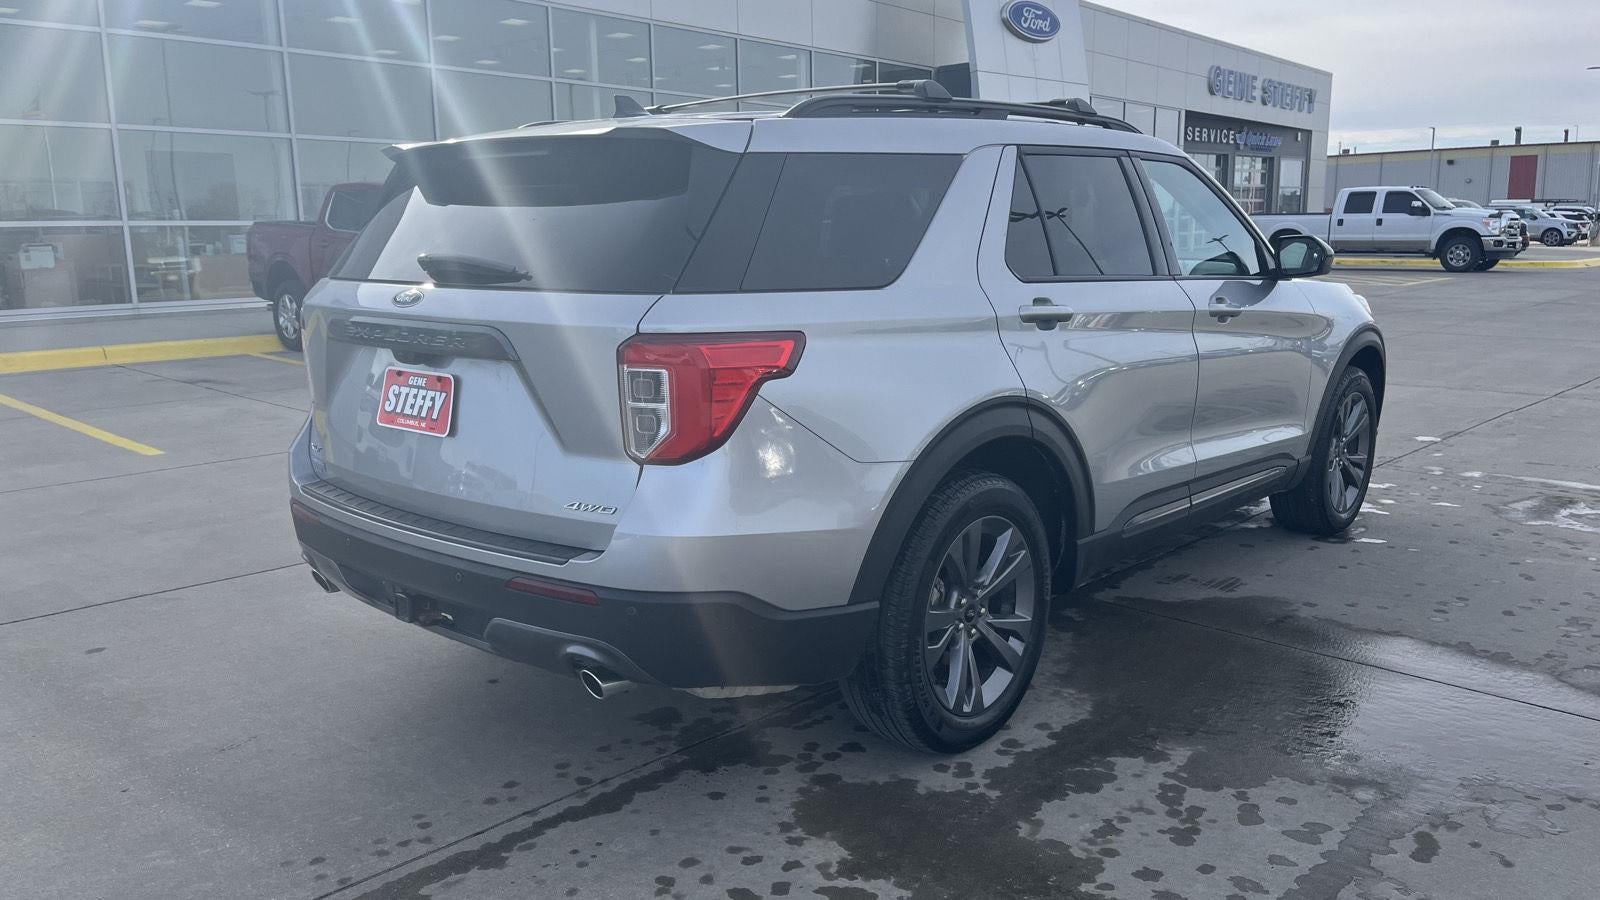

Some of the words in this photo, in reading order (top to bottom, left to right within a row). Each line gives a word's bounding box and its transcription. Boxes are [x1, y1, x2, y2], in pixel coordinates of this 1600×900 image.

[1021, 6, 1051, 31] Ford
[1208, 65, 1258, 103] GENE
[1260, 78, 1317, 113] STEFFY
[1186, 126, 1235, 144] SERVICE
[346, 325, 465, 349] EXPLORER
[408, 376, 428, 387] GENE
[384, 384, 447, 420] STEFFY
[564, 501, 618, 515] 4WD
